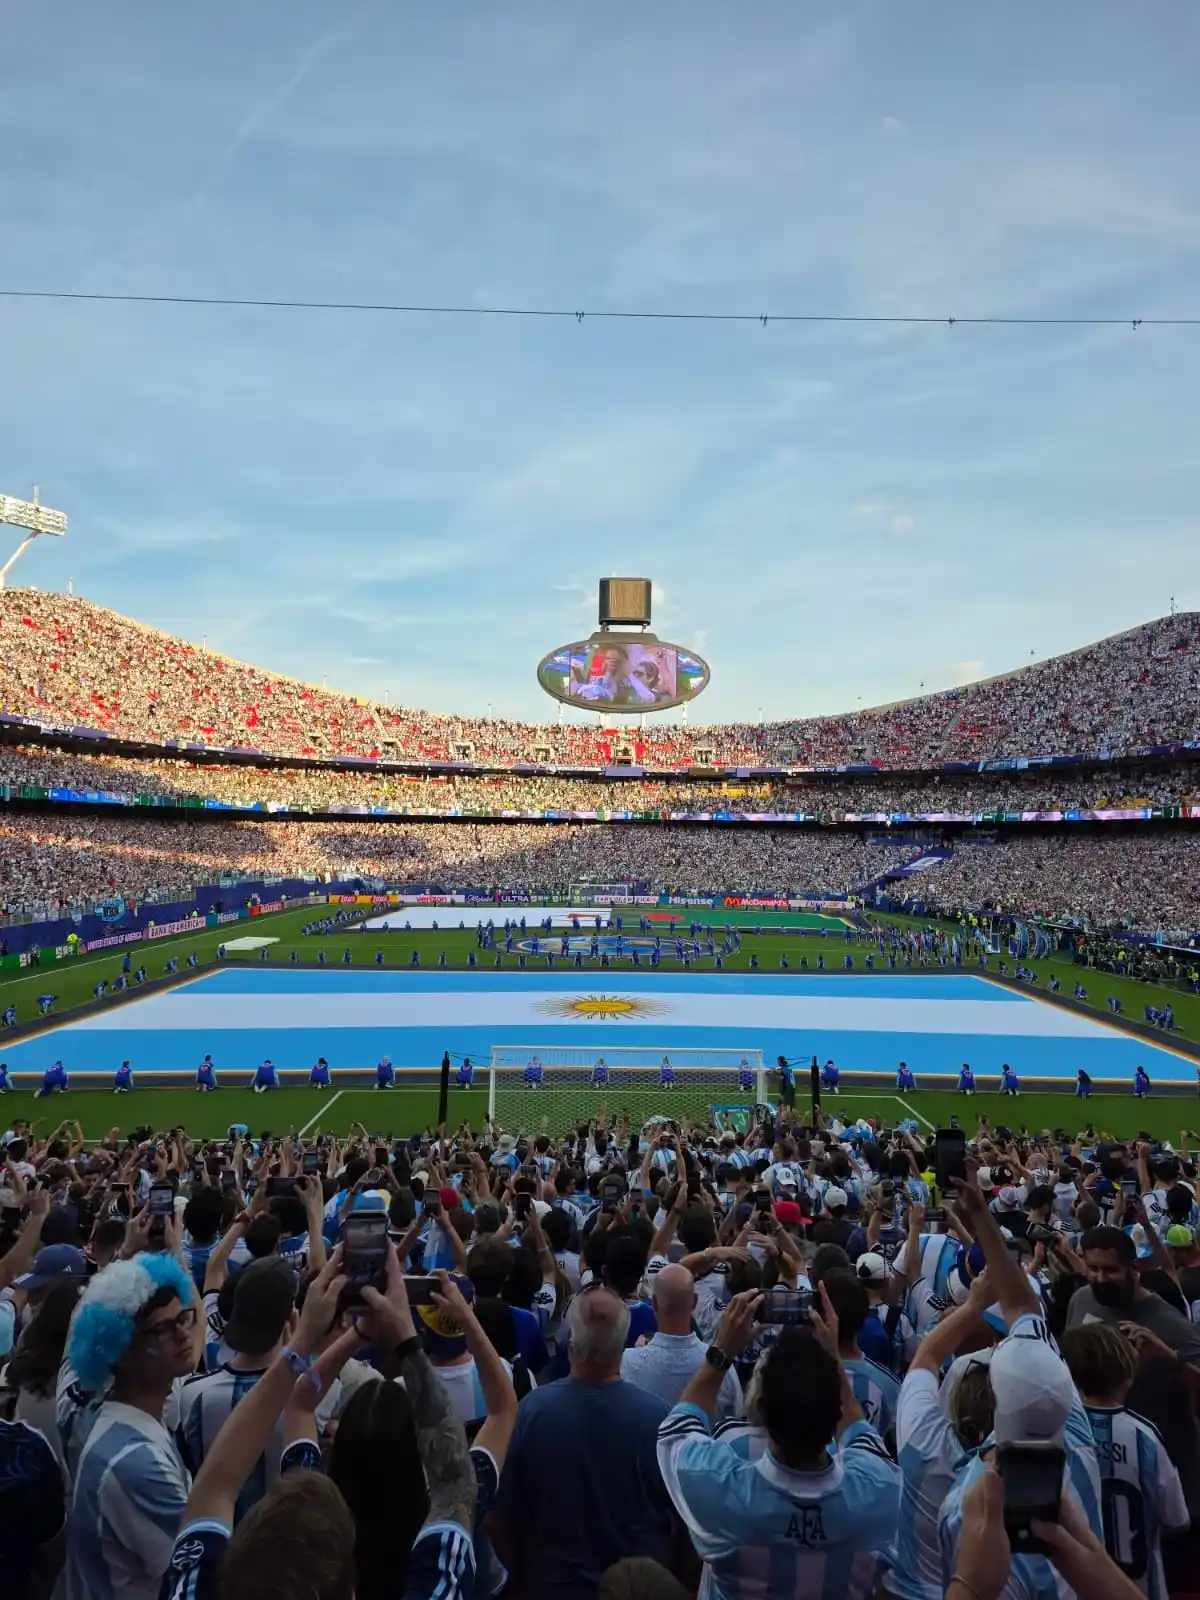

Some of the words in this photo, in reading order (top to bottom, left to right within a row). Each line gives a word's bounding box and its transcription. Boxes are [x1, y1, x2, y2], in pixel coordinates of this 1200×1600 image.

[416, 895, 447, 903] verizon
[668, 896, 713, 904] Hisense
[741, 899, 788, 907] McDonald's
[151, 924, 167, 937] BANK
[176, 918, 199, 931] AMERICA
[1096, 1440, 1127, 1465] SSI
[784, 1502, 827, 1548] AFA
